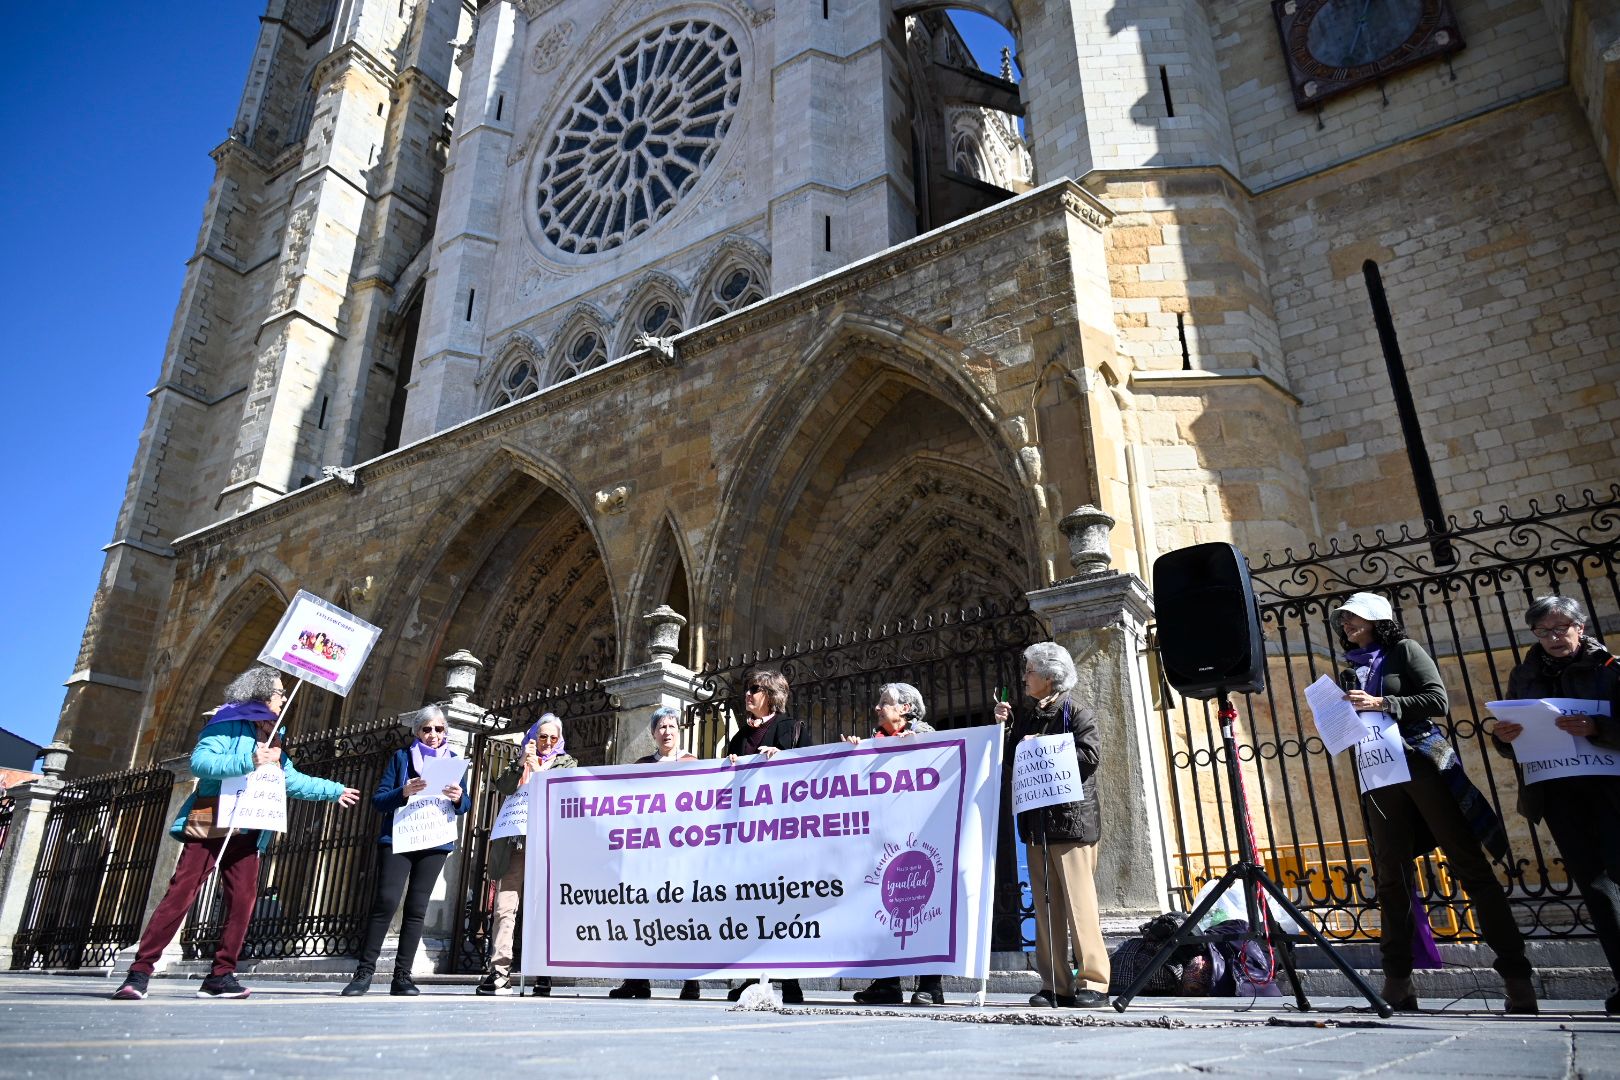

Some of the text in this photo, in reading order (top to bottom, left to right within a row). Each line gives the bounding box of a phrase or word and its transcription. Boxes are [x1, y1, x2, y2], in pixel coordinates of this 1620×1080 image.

[1035, 744, 1060, 758] QUE
[1527, 754, 1615, 774] FEMINISTAS
[1018, 758, 1055, 776] SEAMOS
[675, 788, 733, 813] QUE
[739, 783, 773, 808] LA
[781, 767, 940, 804] IGUALDAD
[1015, 784, 1072, 806] DE IGUALES
[608, 811, 870, 851] SEA COSTUMBRE!!!
[864, 832, 944, 885] Revuelta de mujeres
[560, 876, 844, 905] Revuelta de las mujeres
[887, 869, 930, 896] igualdad
[576, 914, 821, 946] en la Iglesia de León
